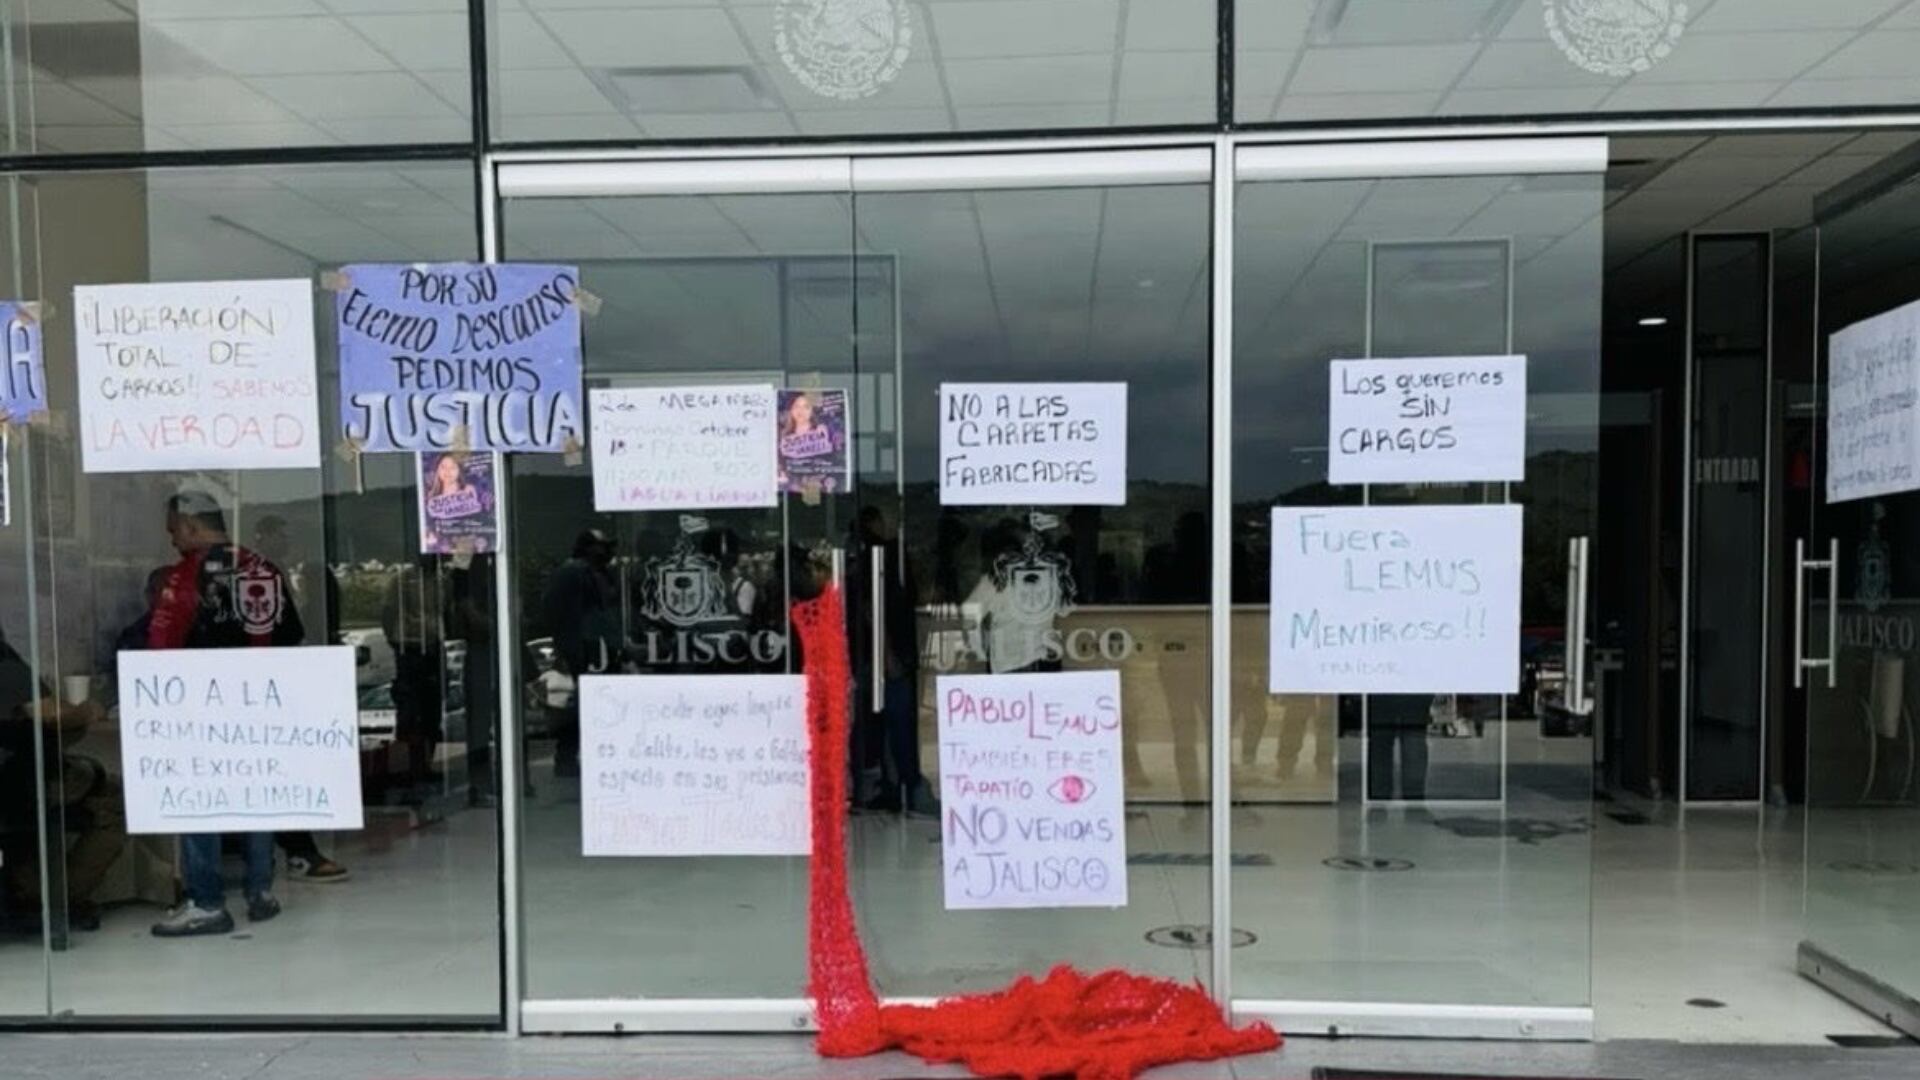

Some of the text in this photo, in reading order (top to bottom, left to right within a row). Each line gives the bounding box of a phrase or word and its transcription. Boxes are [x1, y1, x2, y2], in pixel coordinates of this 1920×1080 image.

[401, 267, 497, 306] POR SU
[96, 340, 258, 368] TOTAL DE
[211, 376, 312, 399] SABEMOS
[392, 356, 541, 392] PEDIMOS
[1343, 368, 1503, 395] Los queremos
[659, 393, 719, 410] MEGA
[948, 394, 1069, 422] NO A LAS
[90, 412, 304, 452] LA VERDAD
[345, 391, 576, 449] JUSTICIA
[958, 420, 1099, 447] CARPETAS
[1340, 426, 1457, 454] CARGOS
[946, 455, 1097, 488] FABRICADAS
[1696, 457, 1759, 483] ENTRADA
[1300, 514, 1411, 554] Fuera
[1345, 558, 1481, 595] LEMUS
[587, 630, 783, 673] JLISCO
[134, 675, 283, 707] NO A LA
[947, 688, 1119, 740] PABLO LEMUS
[134, 719, 354, 750] CRIMINALIZACIÓN
[139, 756, 285, 780] POR EXIGIR
[944, 742, 1112, 771] TAMBIÉN ERES
[160, 786, 330, 811] AGUA LIMPIA
[946, 774, 1034, 800] TAPATÍO
[948, 805, 1113, 847] NO VENDAS
[953, 852, 1109, 898] A JALISCO
